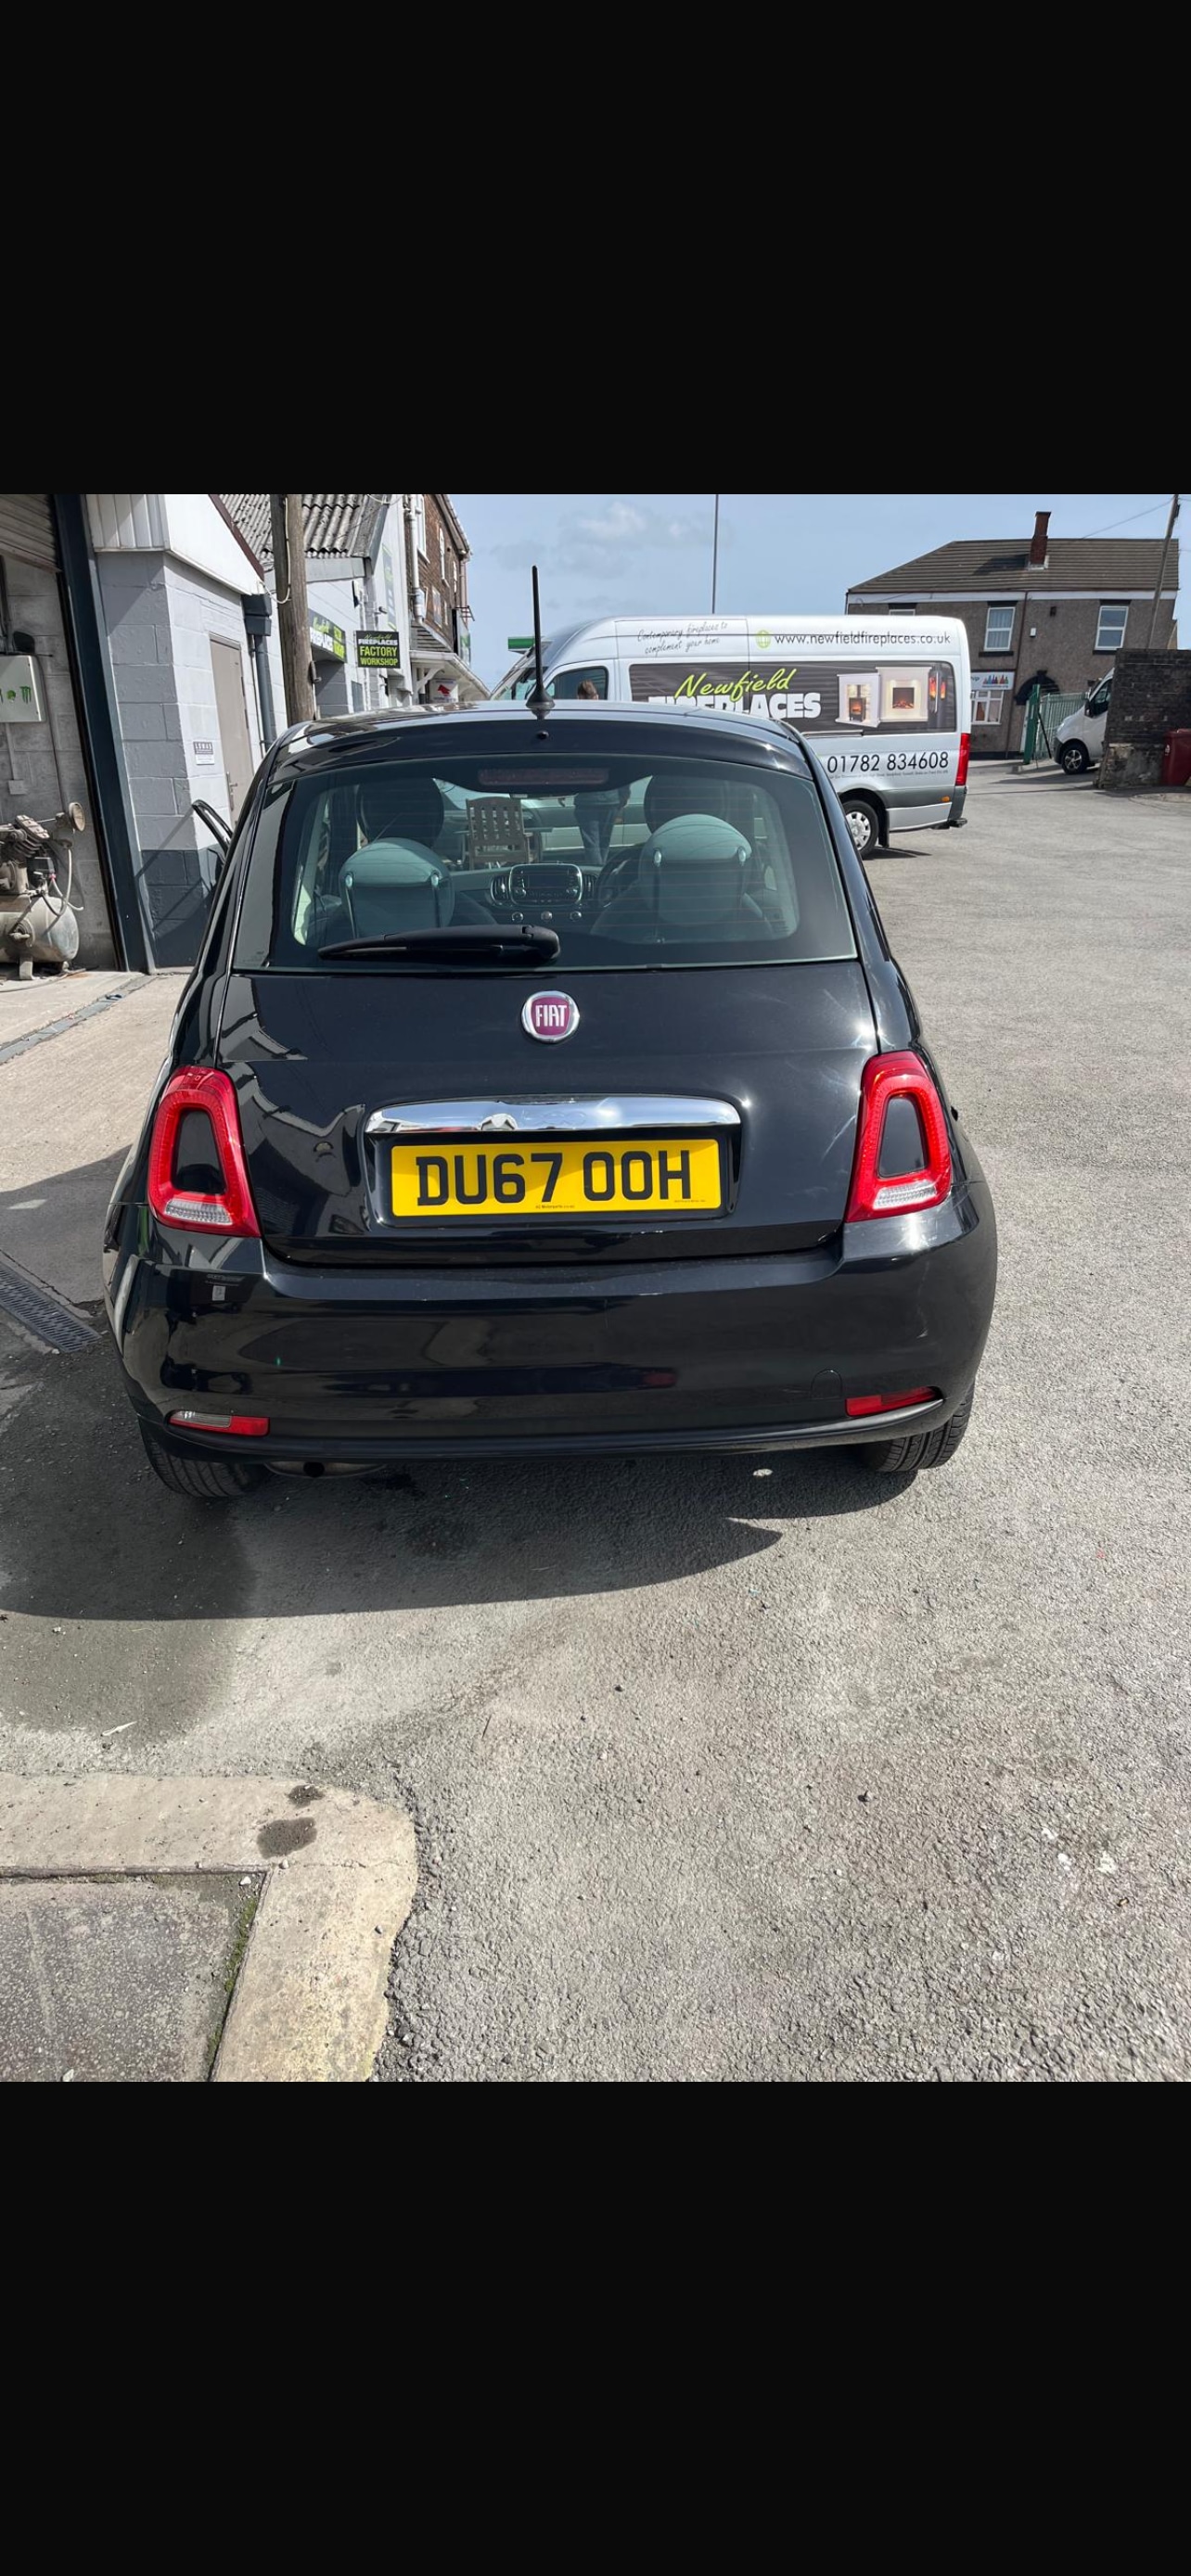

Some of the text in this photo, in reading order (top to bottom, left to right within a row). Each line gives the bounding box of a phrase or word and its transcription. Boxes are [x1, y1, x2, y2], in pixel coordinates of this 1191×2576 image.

[775, 631, 951, 647] www.newfieldfireplaces.co.uk
[359, 645, 398, 657] FACTORY
[360, 657, 398, 667] WORKSHOP
[673, 668, 797, 702] Newfield
[826, 751, 949, 773] 01782 834608
[535, 1004, 568, 1027] FIAT
[416, 1150, 691, 1206] DU67 OOH
